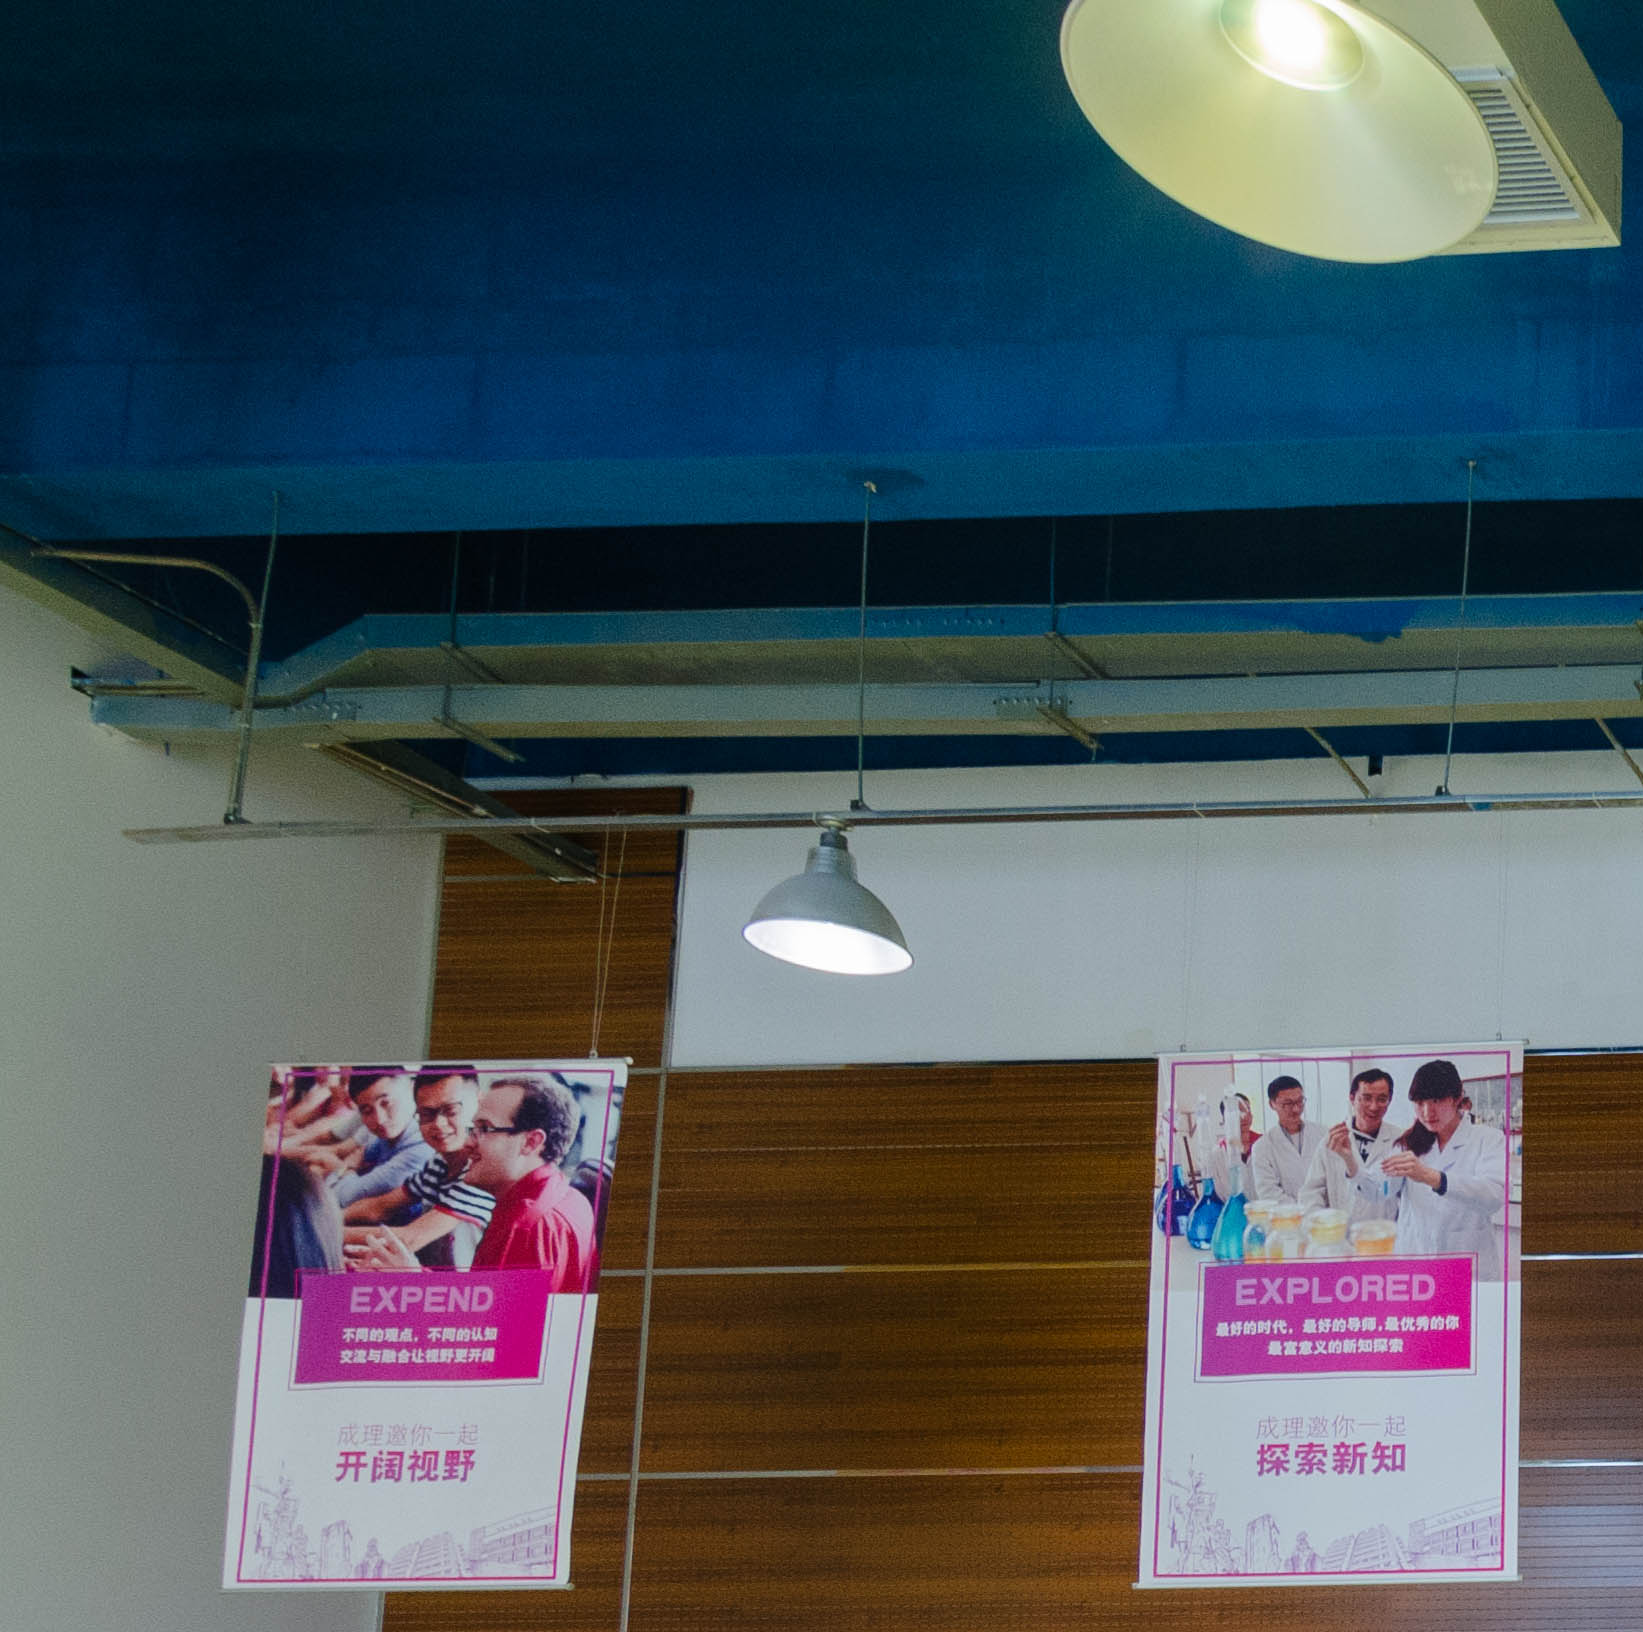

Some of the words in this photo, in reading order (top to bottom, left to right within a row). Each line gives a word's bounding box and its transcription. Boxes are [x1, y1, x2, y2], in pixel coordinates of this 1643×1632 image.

[349, 1286, 495, 1314] EXPEND
[1235, 1273, 1436, 1306] EXPLORED
[336, 1422, 481, 1447] 成理邀你一起
[1256, 1414, 1408, 1439] 成理邀你一起
[335, 1449, 476, 1483] 开阔视野
[1256, 1441, 1407, 1477] 探索新知
